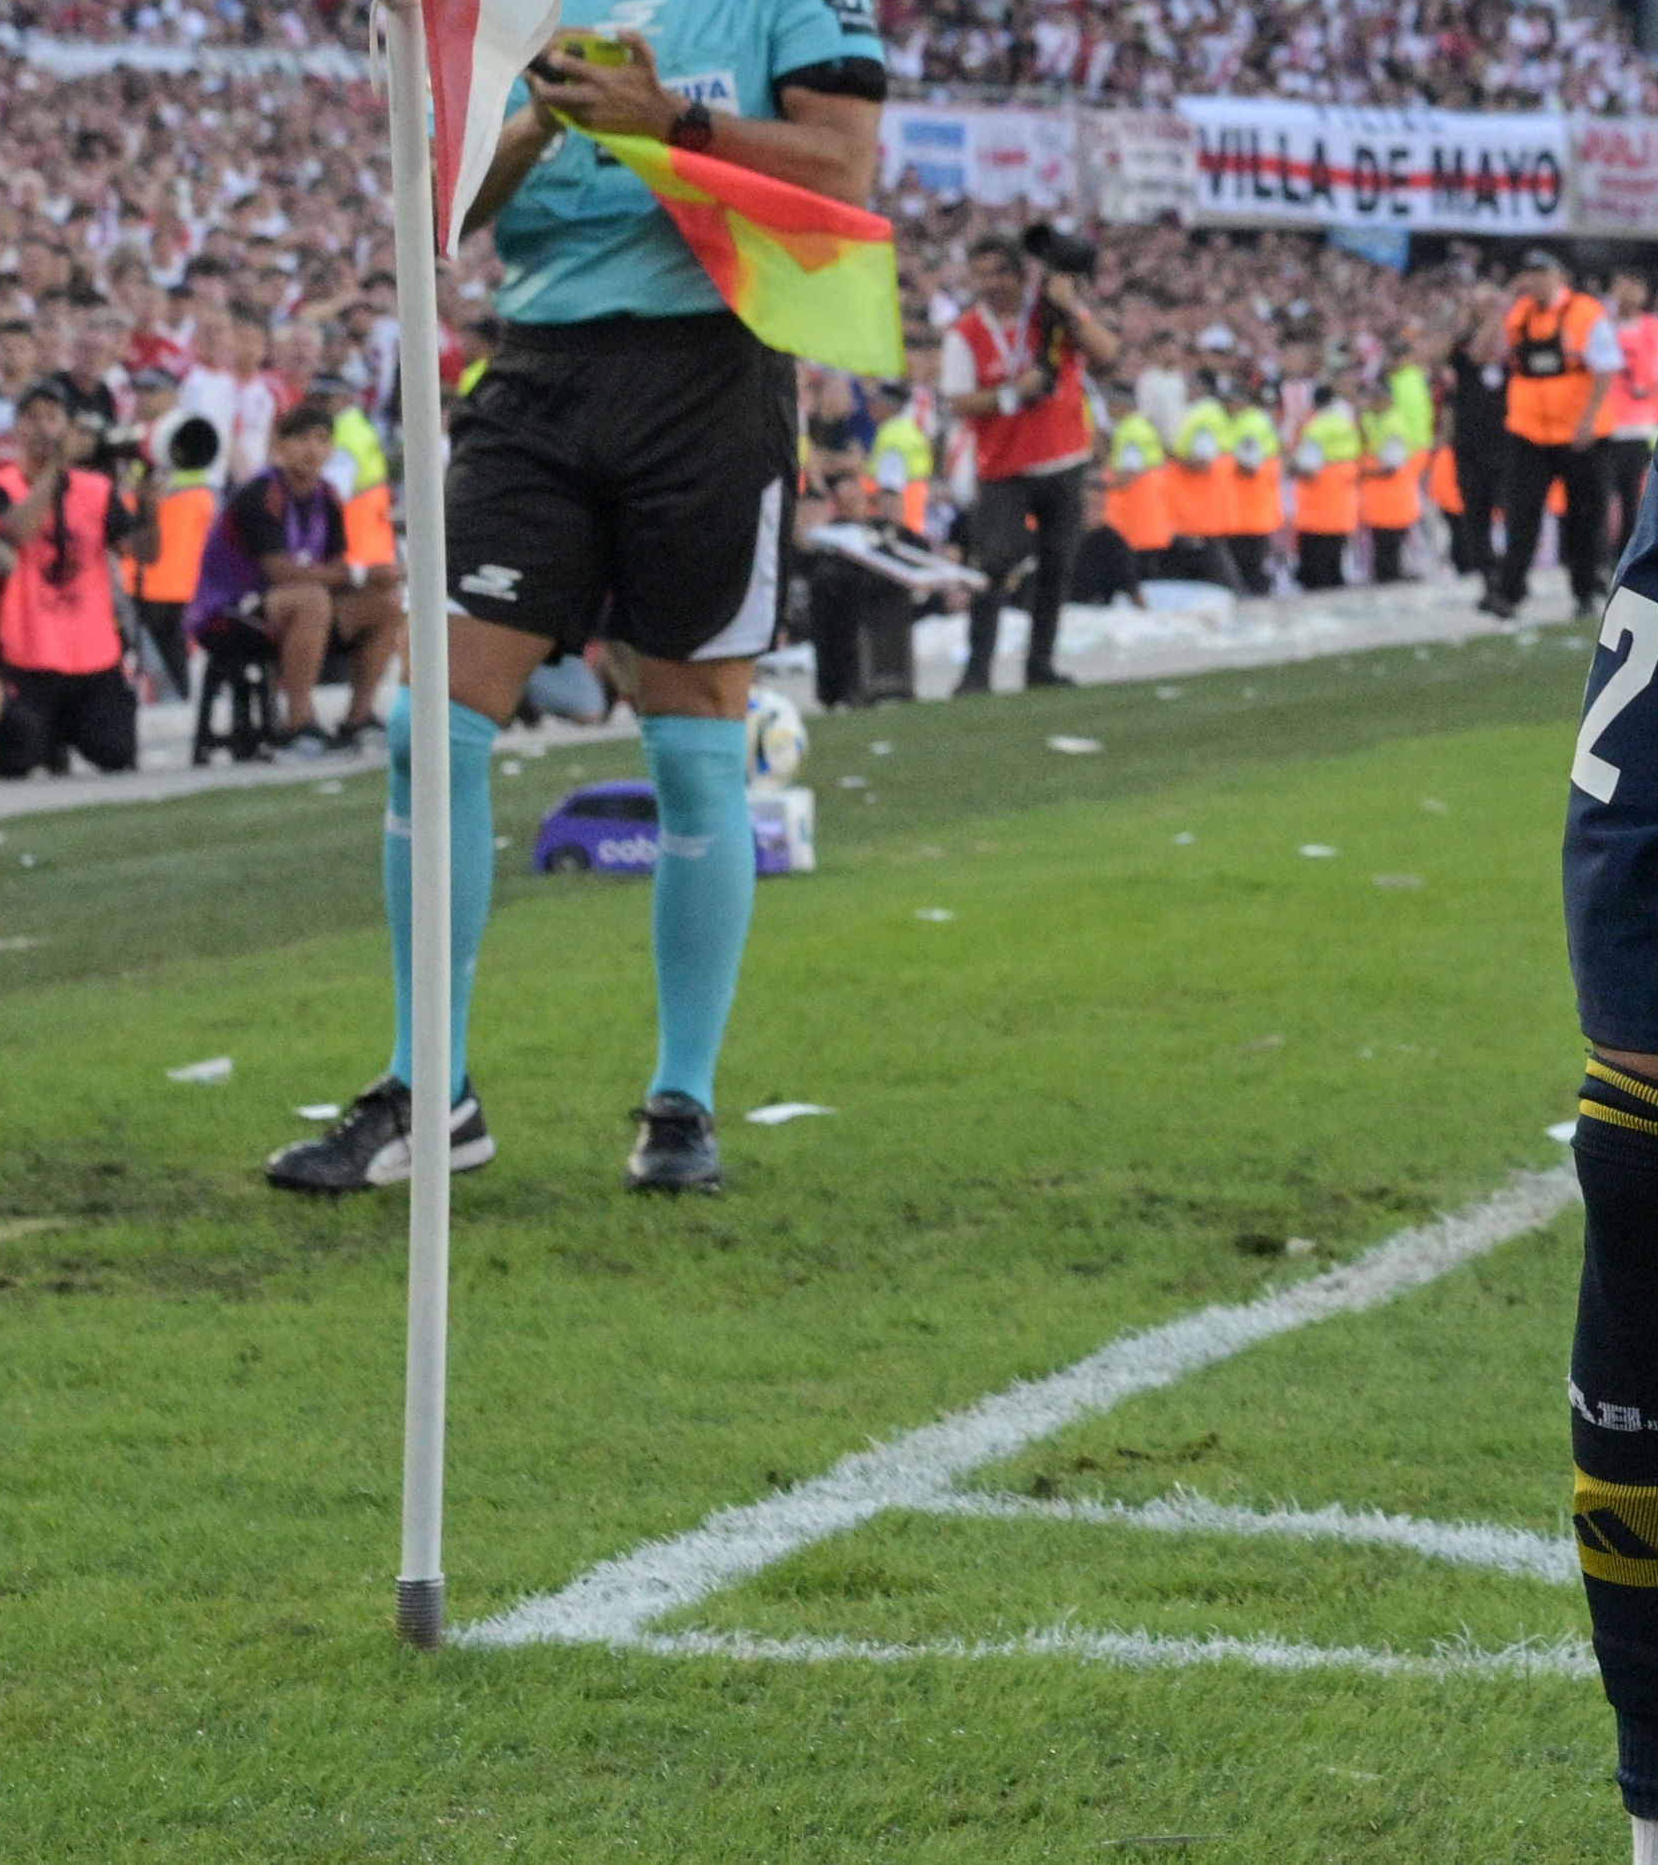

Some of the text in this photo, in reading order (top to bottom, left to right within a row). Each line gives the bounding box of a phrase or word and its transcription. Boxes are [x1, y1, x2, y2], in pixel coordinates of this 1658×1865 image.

[1199, 130, 1334, 205] VILLA
[1355, 145, 1410, 214] DE
[1432, 148, 1561, 215] MAYO
